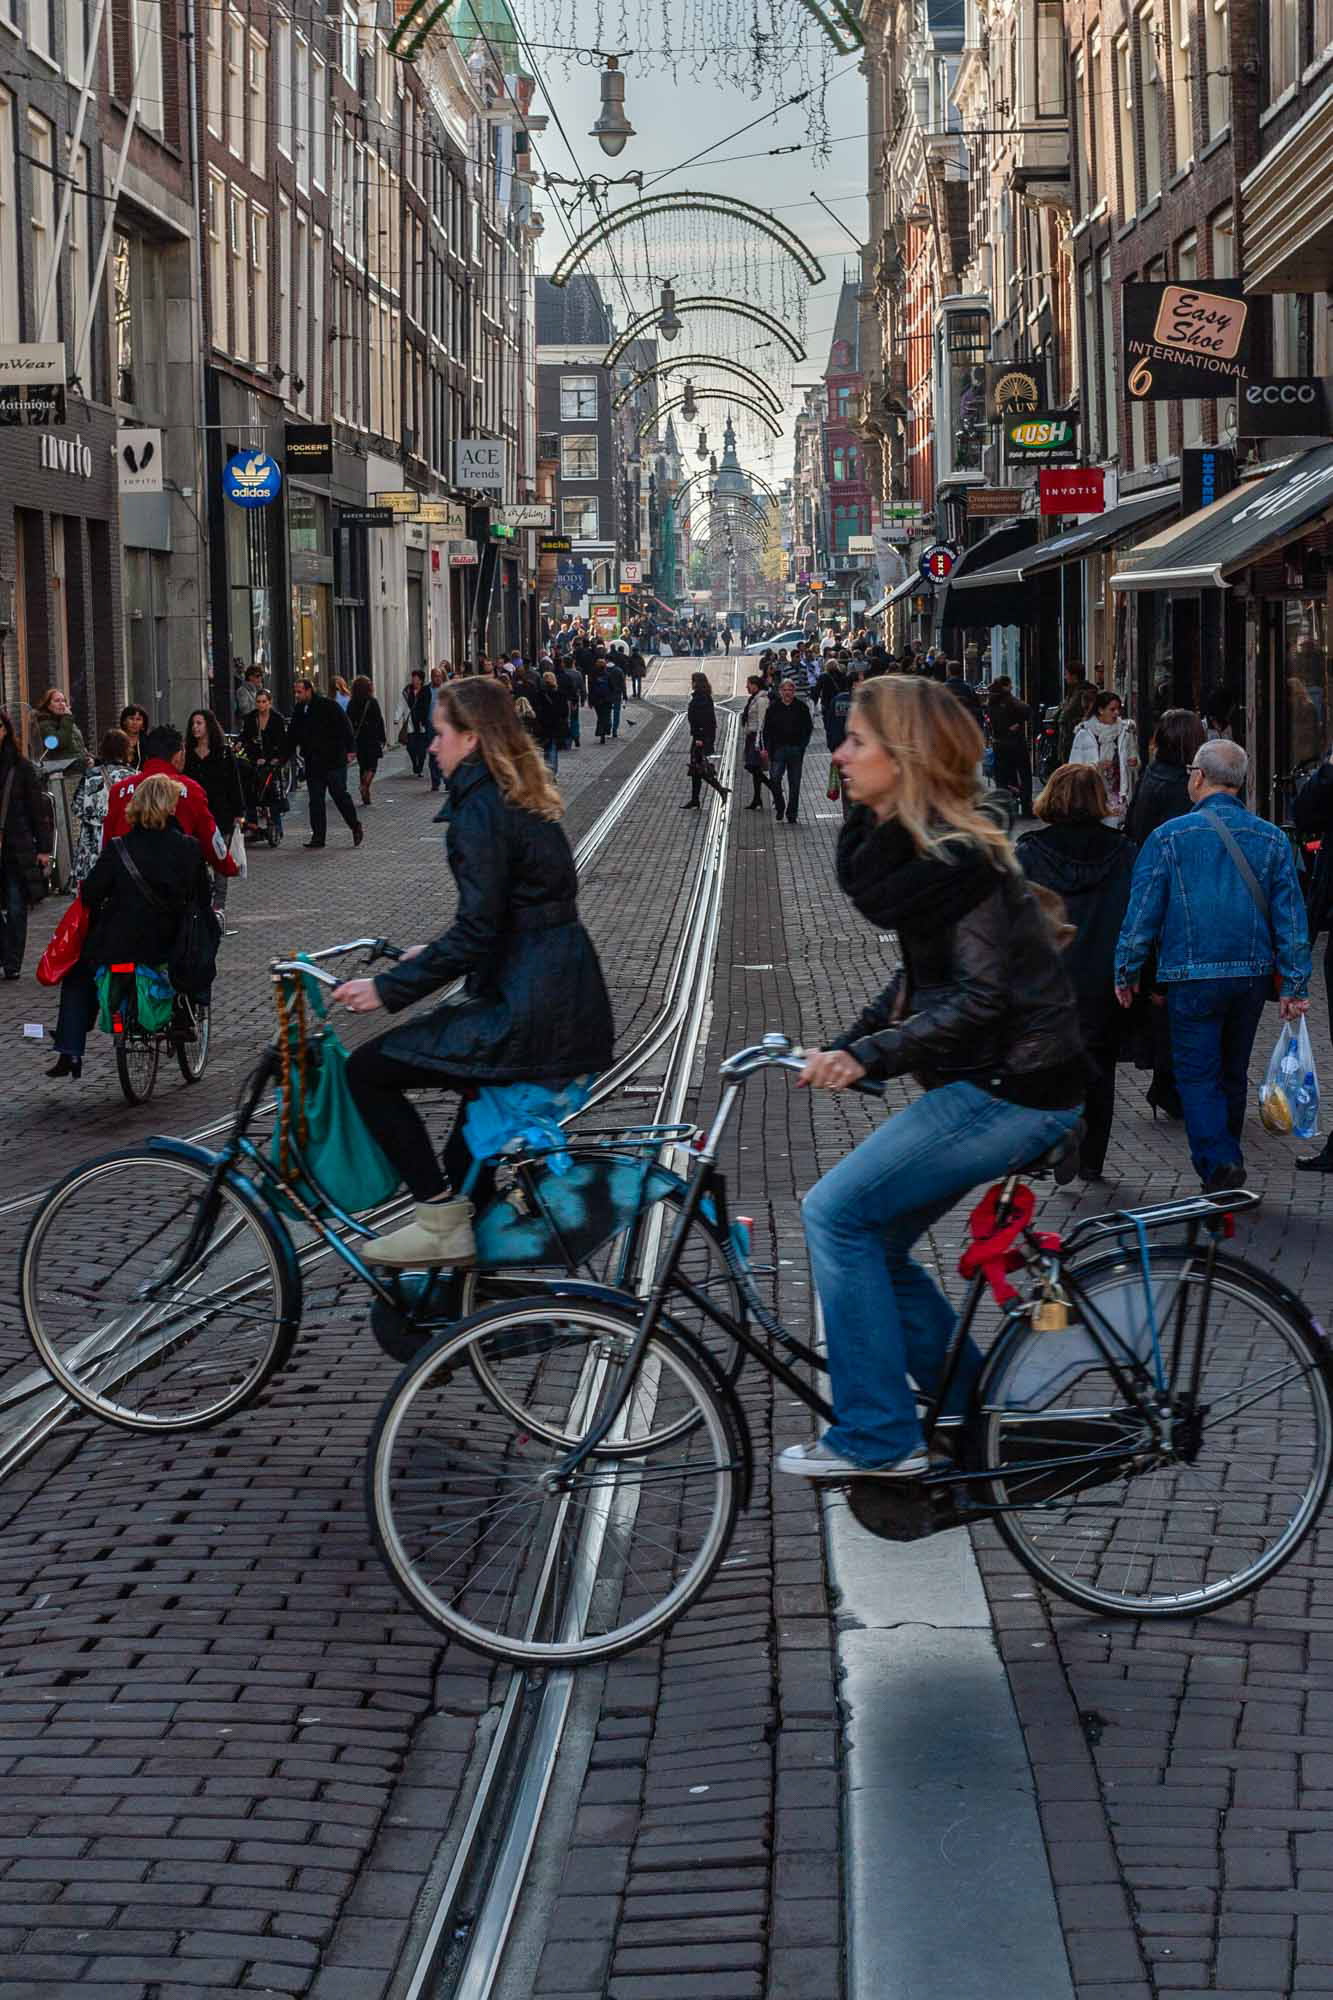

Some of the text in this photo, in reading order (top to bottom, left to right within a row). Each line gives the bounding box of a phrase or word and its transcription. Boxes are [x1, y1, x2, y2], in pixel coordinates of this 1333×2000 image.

[1172, 294, 1231, 333] Easy
[1166, 321, 1225, 351] Shoe
[1128, 340, 1249, 378] INTERNATIONAL
[1128, 356, 1153, 396] 6
[1246, 385, 1316, 405] ecco
[995, 402, 1038, 415] PAUW
[1015, 421, 1067, 442] LUSH
[462, 449, 500, 465] ACE
[462, 467, 501, 479] Trends
[232, 488, 271, 498] adidas
[1046, 487, 1097, 496] INVOTIS
